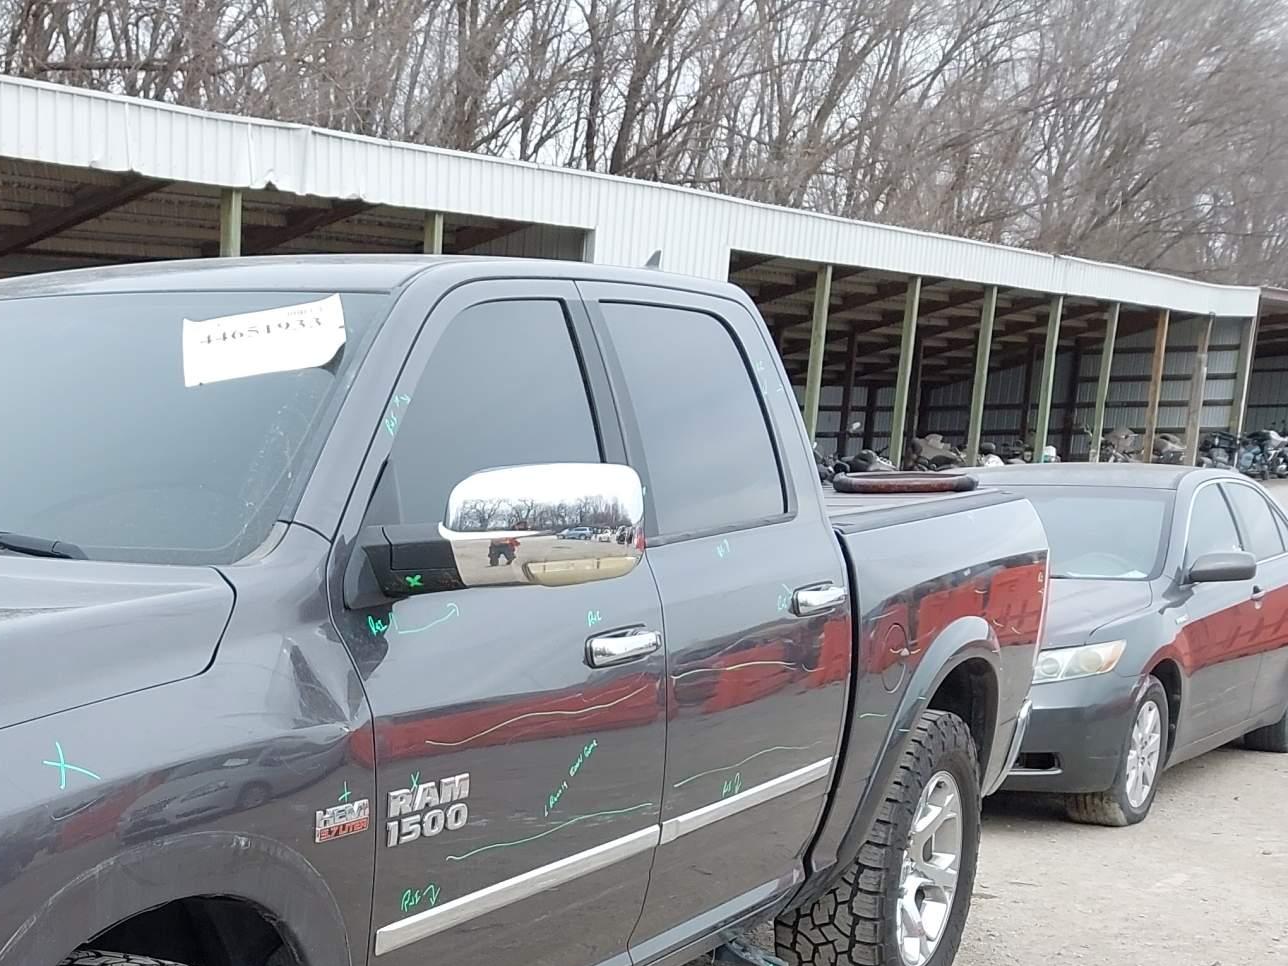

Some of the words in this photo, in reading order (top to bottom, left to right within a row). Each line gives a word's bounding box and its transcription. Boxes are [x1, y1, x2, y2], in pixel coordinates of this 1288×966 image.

[315, 799, 370, 829] HEMI
[386, 772, 471, 818] RAM
[338, 820, 368, 836] LITER
[386, 802, 469, 848] 1500
